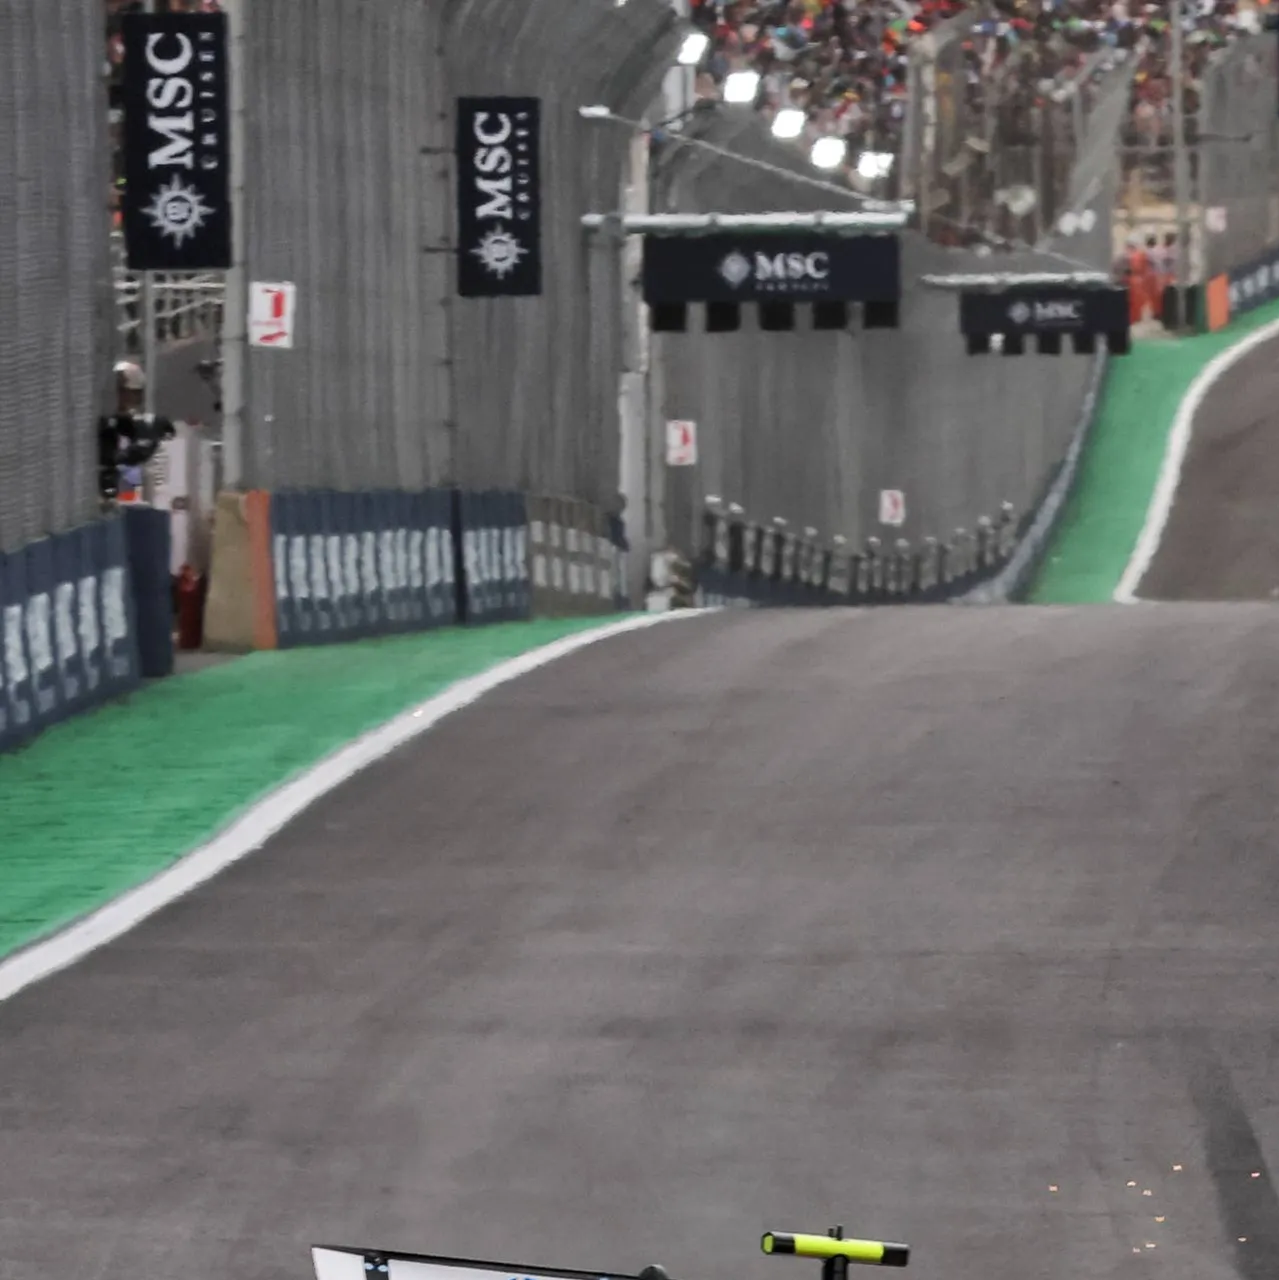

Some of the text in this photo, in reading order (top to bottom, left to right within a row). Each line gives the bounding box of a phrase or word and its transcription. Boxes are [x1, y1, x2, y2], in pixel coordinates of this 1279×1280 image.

[145, 31, 194, 170] MSC
[473, 111, 513, 220] MSC
[754, 251, 830, 280] MSC
